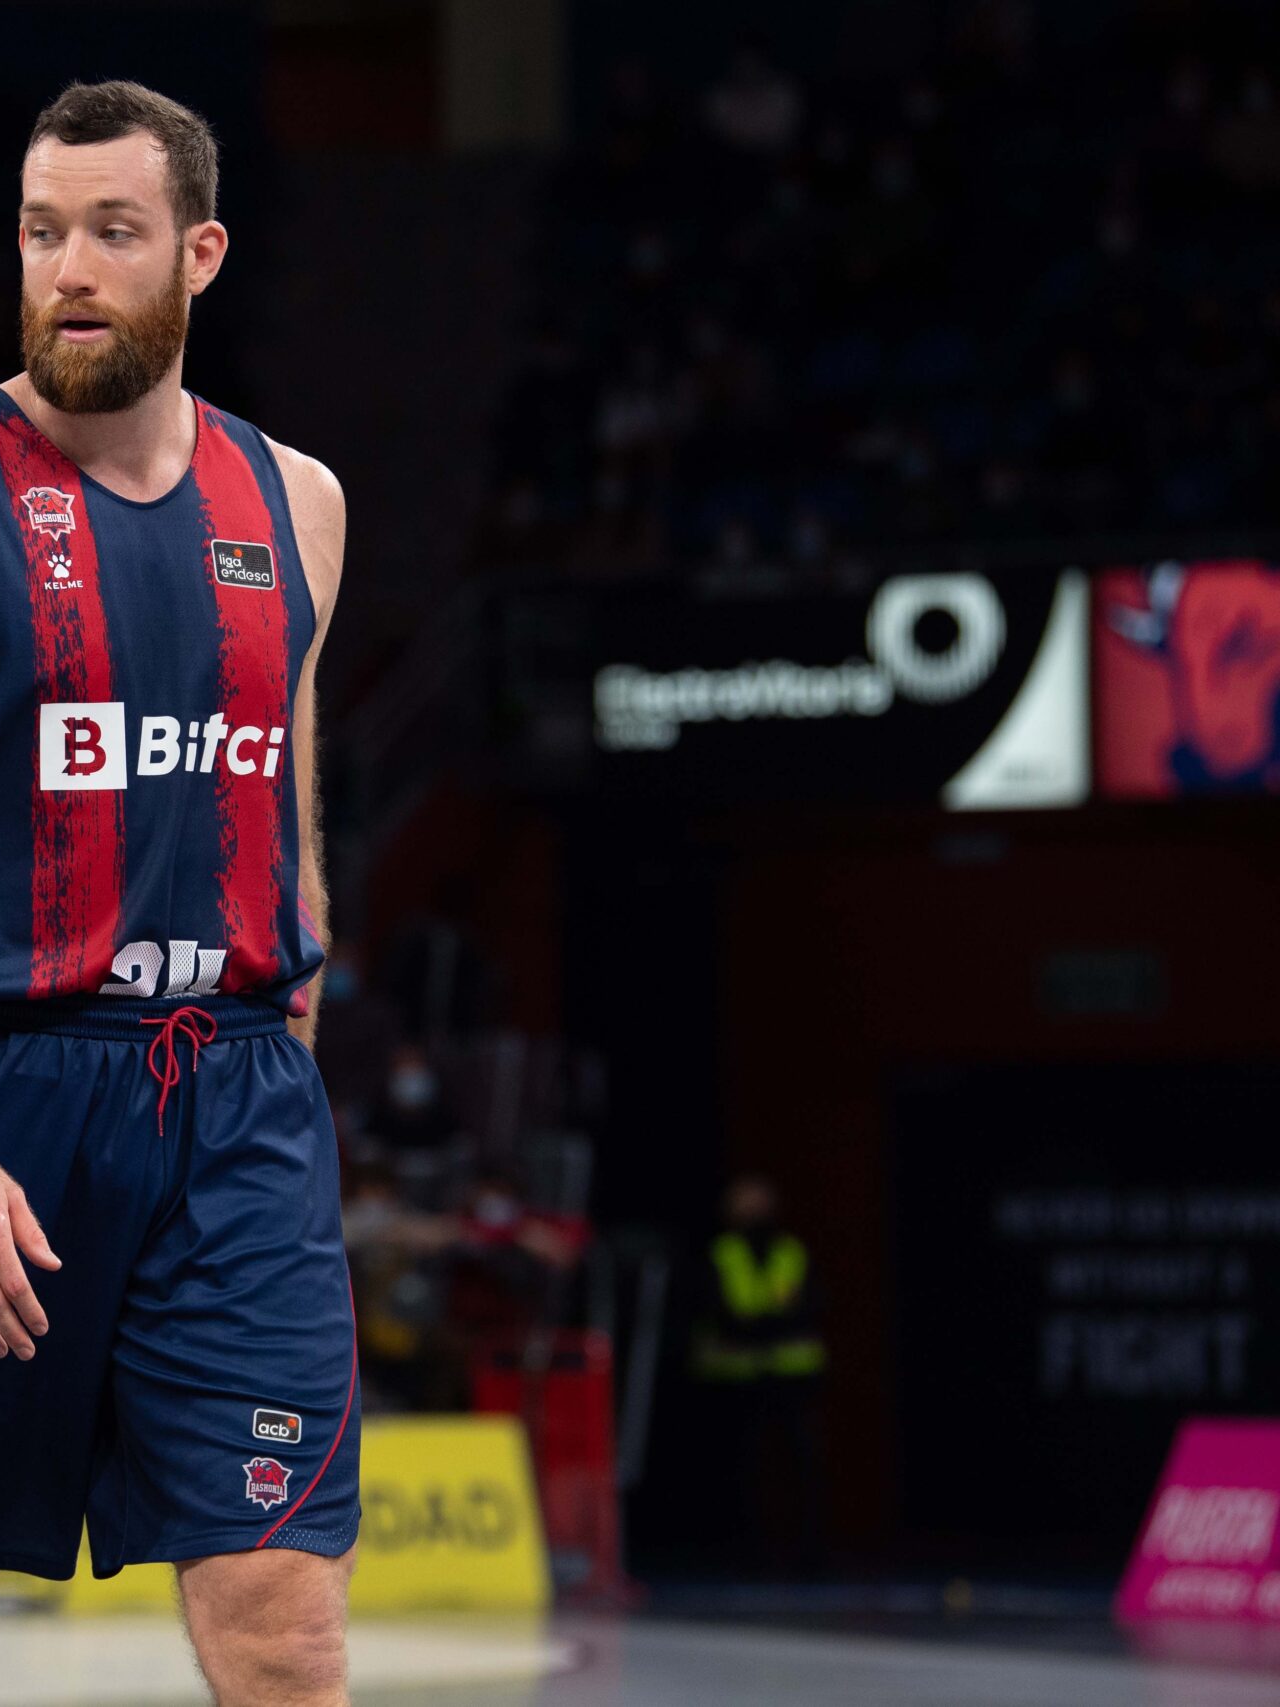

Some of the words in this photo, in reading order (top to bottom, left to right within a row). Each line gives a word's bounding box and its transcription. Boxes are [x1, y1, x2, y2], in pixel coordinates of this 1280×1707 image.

[218, 553, 242, 568] liga
[221, 568, 270, 583] endesa
[44, 580, 84, 590] KELME
[136, 712, 286, 778] Bitci
[258, 1422, 290, 1437] acb
